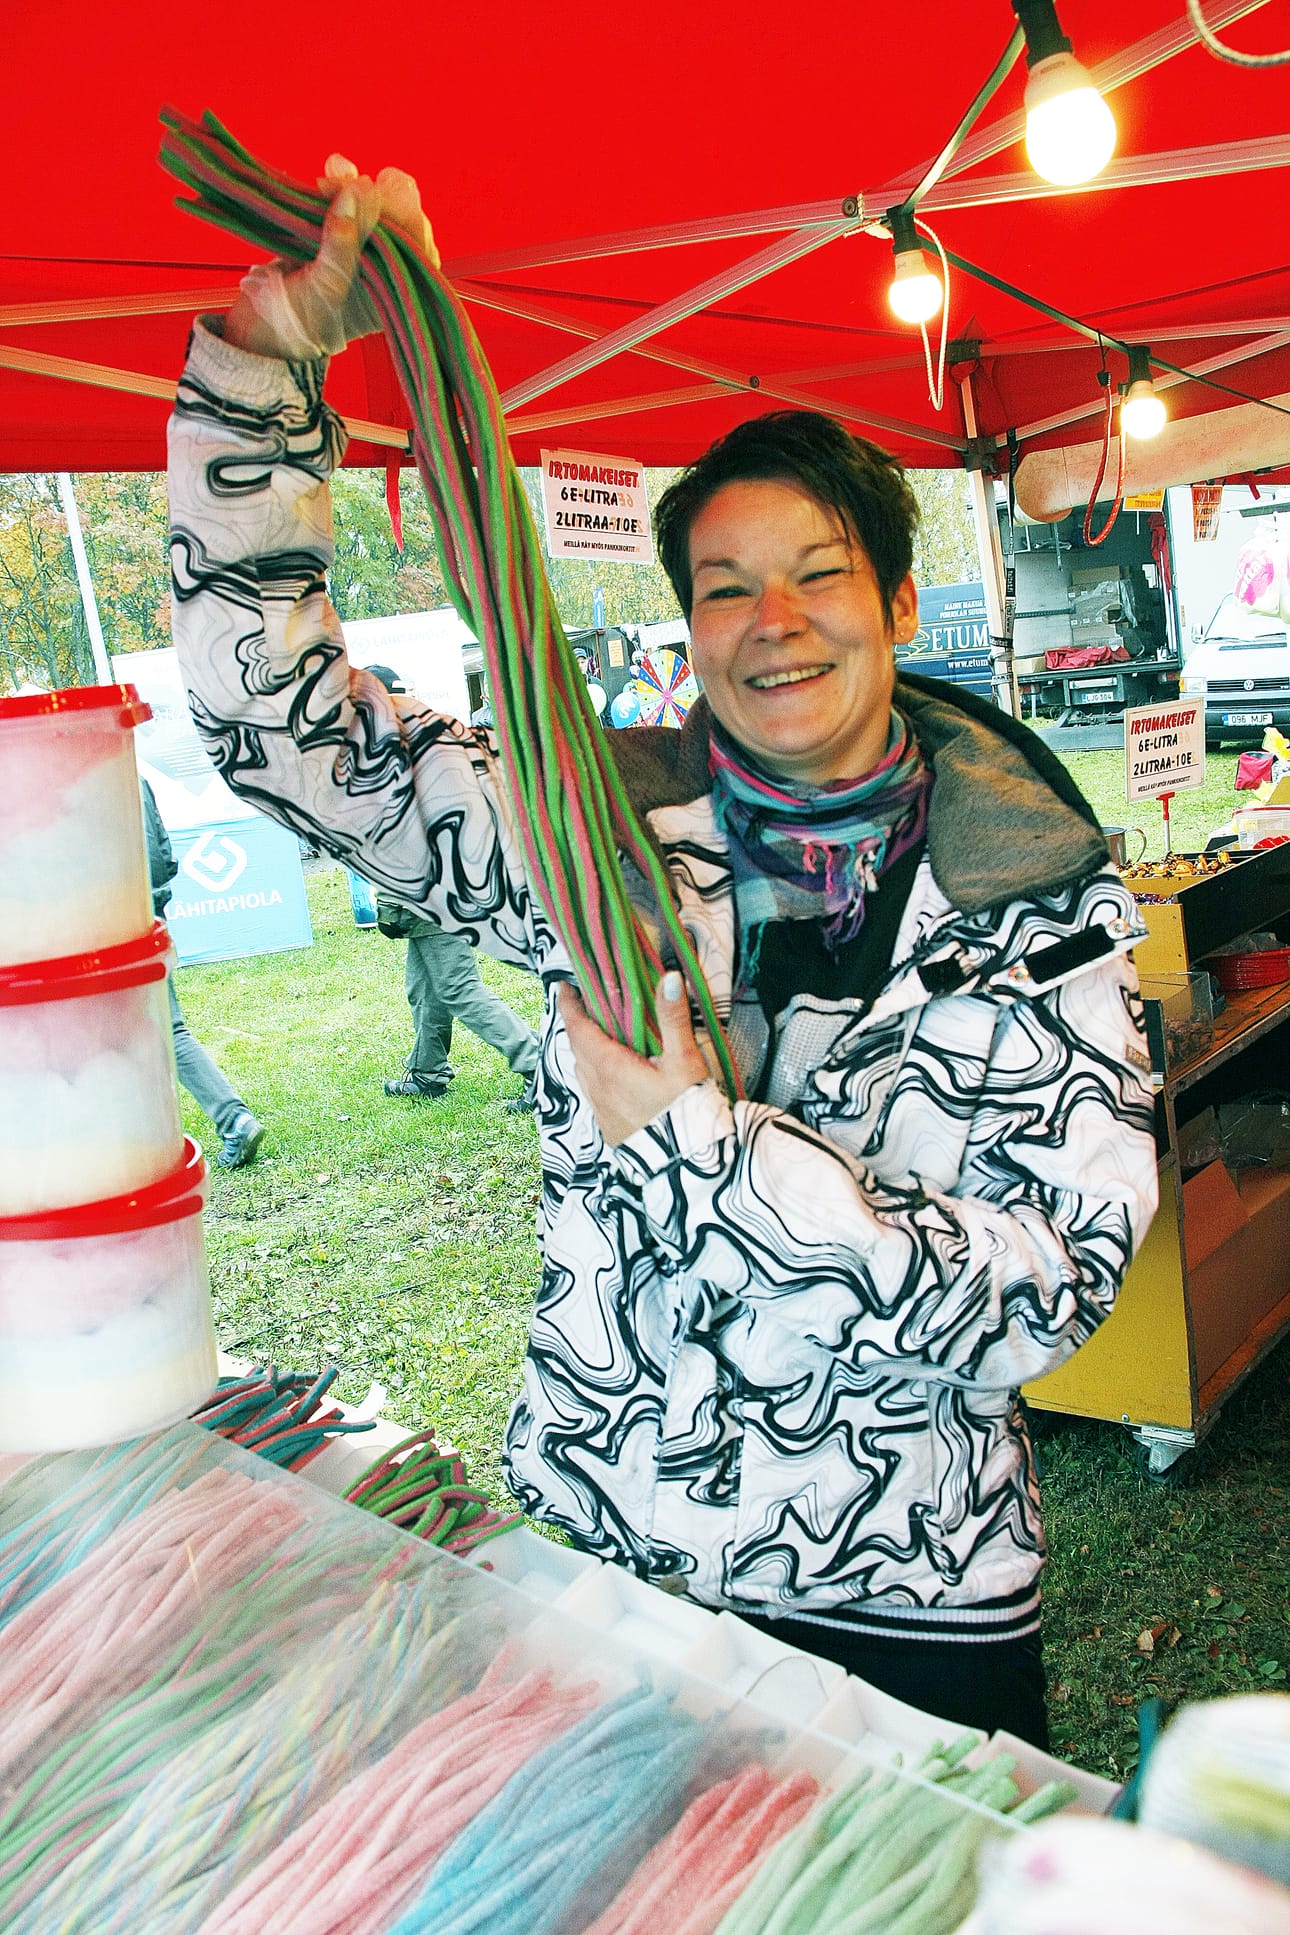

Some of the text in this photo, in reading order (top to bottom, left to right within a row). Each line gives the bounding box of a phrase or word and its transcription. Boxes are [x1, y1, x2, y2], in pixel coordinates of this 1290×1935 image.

[549, 461, 639, 488] IRTOMAKEISET
[1130, 710, 1197, 735] IRTOMAKEISET
[1231, 714, 1269, 723] 096 MJF
[164, 889, 283, 921] LÄHITAPIOLA
